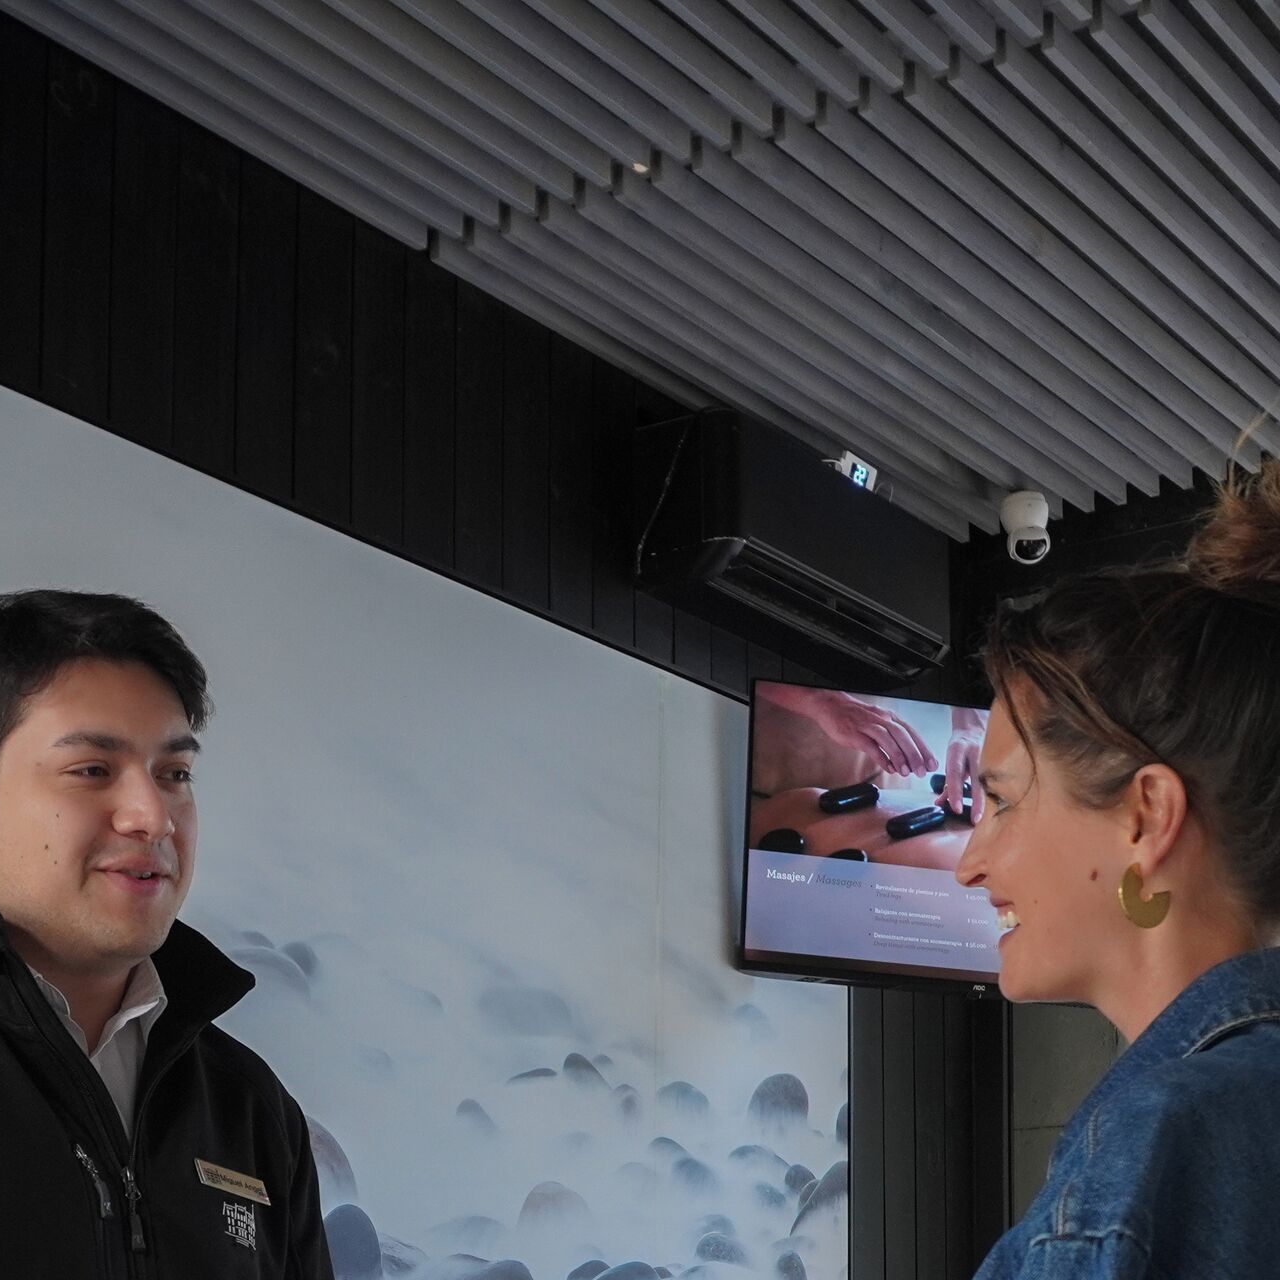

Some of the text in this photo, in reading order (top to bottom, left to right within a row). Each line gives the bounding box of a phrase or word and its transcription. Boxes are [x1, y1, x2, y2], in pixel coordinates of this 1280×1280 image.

[766, 868, 806, 883] Masajes
[816, 874, 862, 889] Massages
[909, 911, 941, 921] aromaterapia
